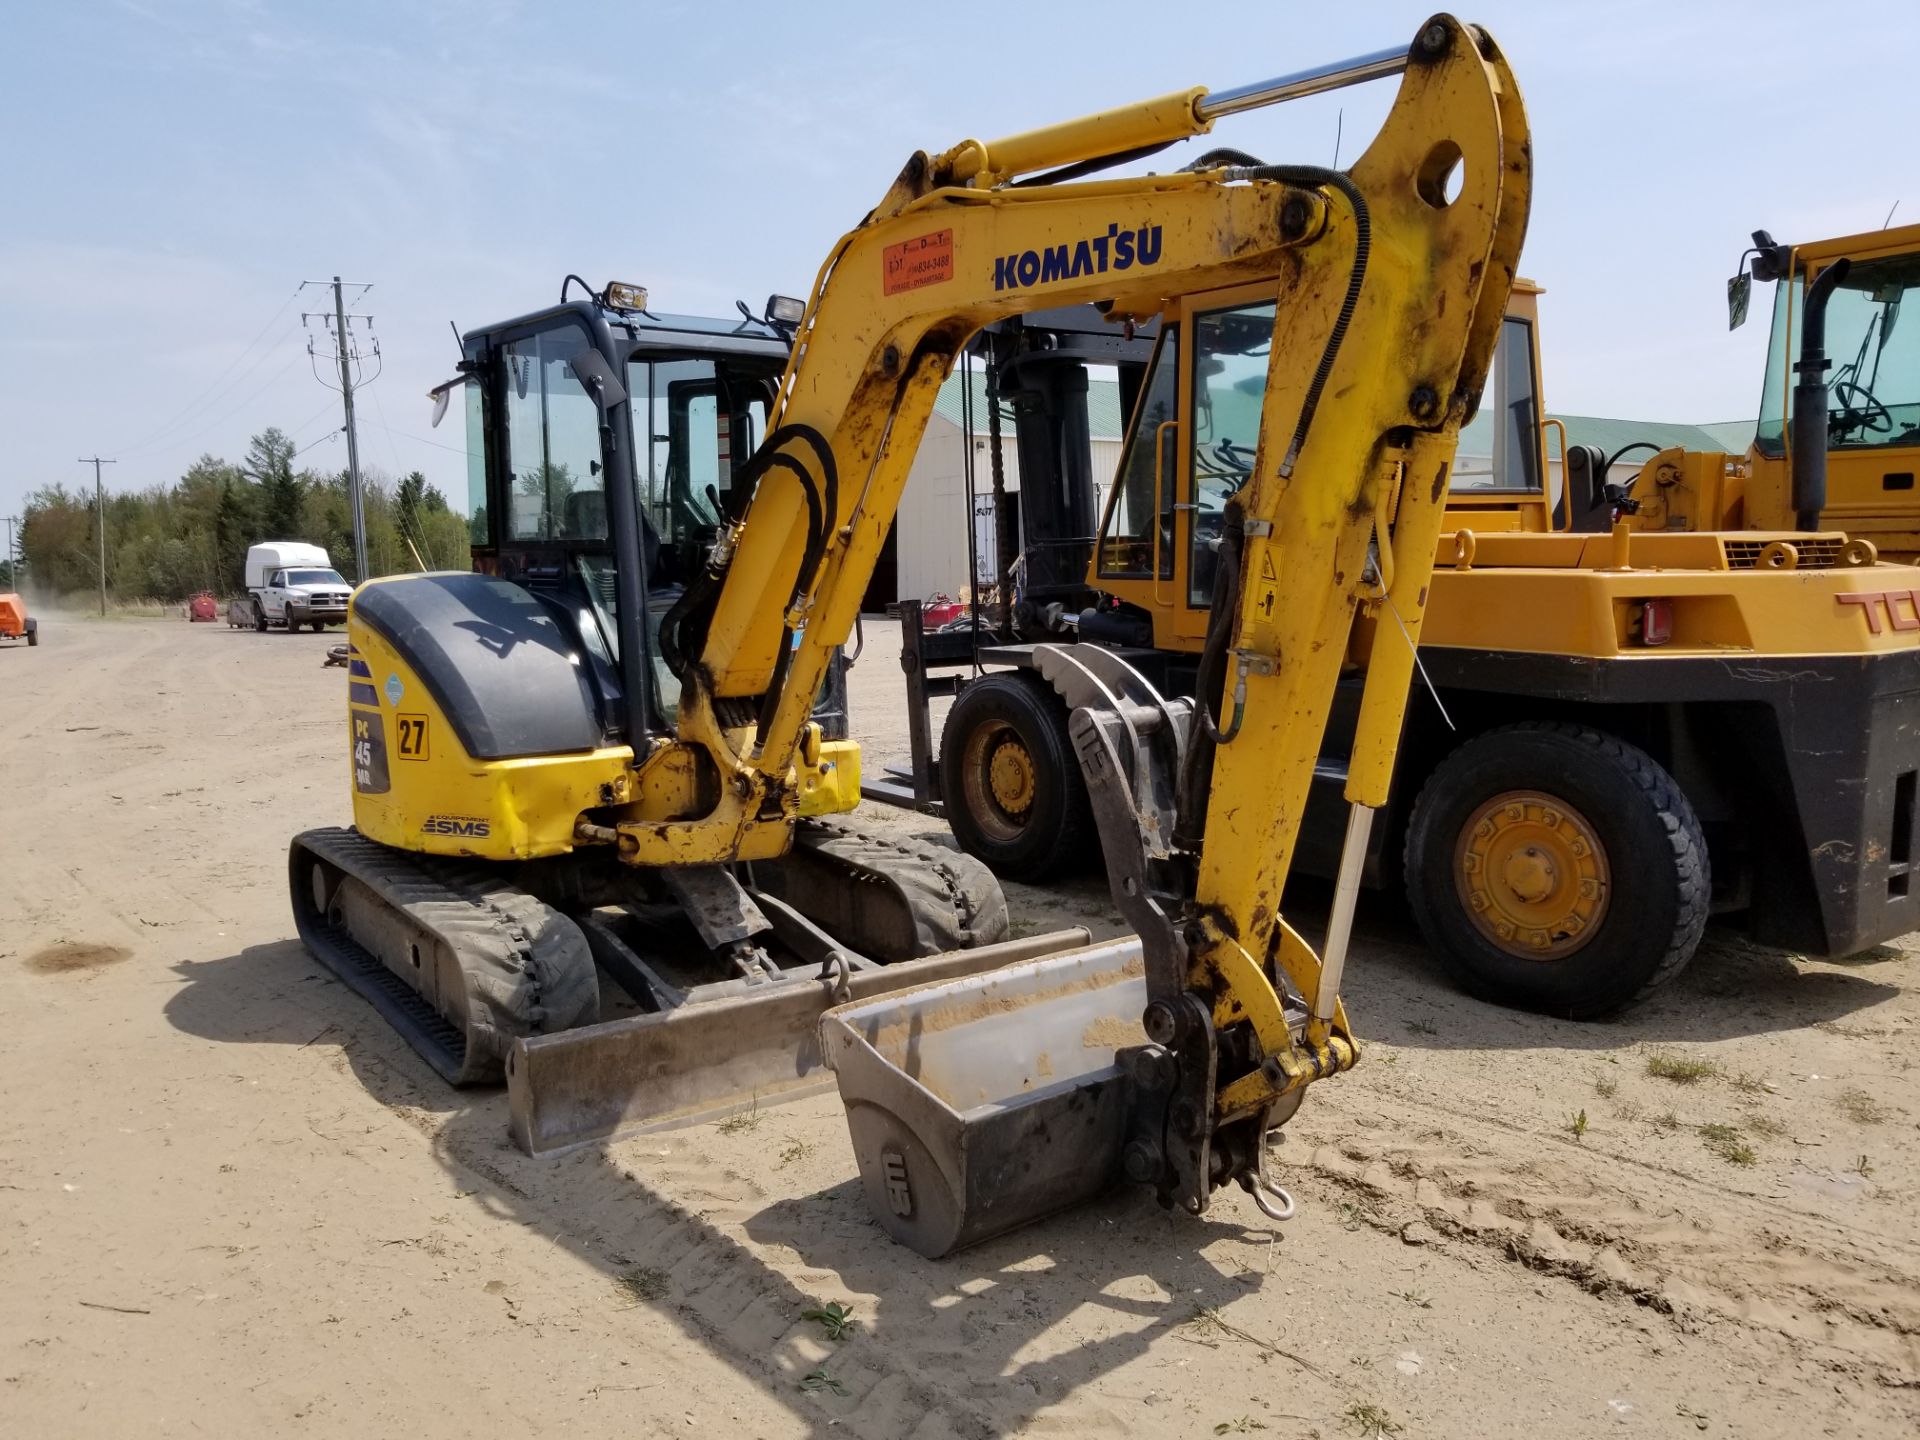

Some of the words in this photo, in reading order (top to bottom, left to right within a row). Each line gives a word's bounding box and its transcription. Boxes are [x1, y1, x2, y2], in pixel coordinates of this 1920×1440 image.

[995, 223, 1162, 291] KOMATSU
[355, 719, 369, 739] PC
[400, 720, 425, 754] 27
[355, 740, 371, 766] 45
[357, 767, 371, 785] MR
[436, 814, 490, 822] EQUIPEMENT
[436, 820, 491, 837] SMS
